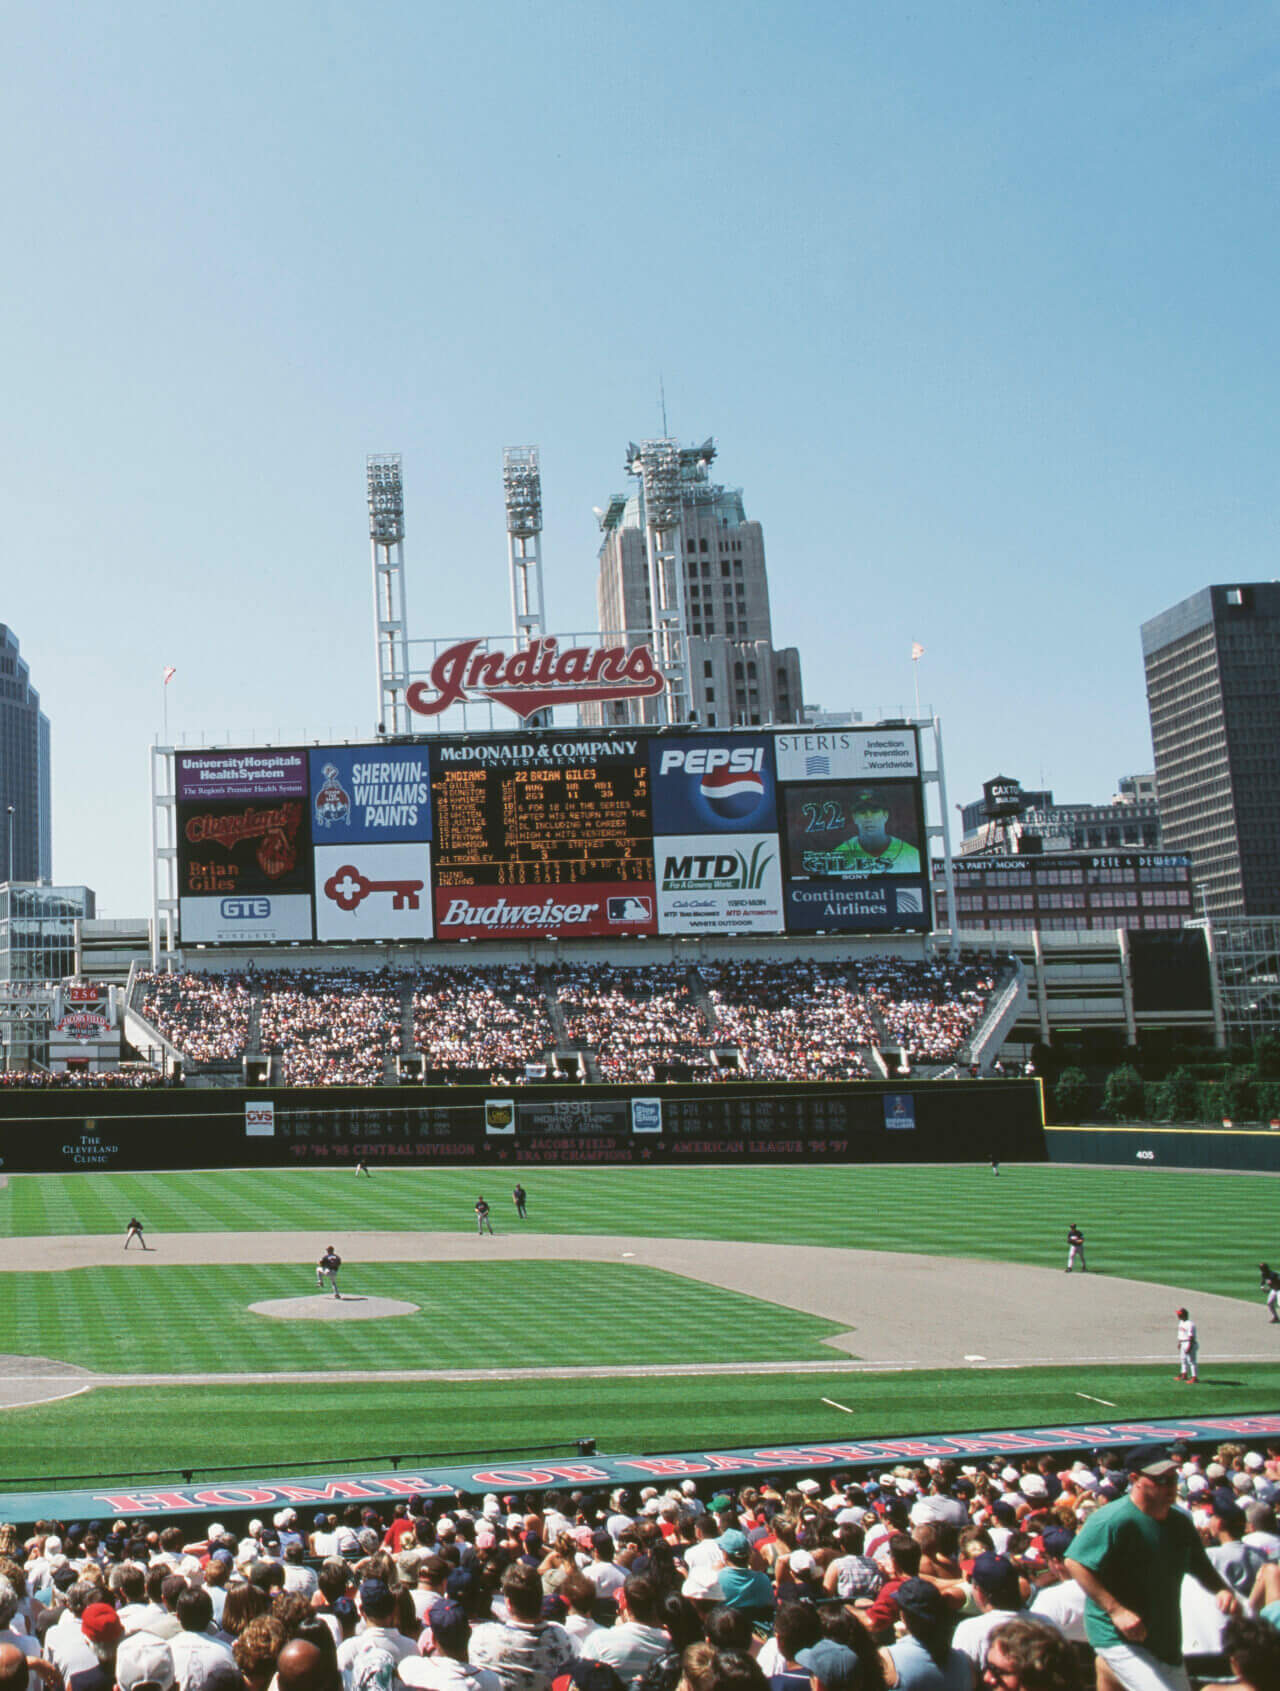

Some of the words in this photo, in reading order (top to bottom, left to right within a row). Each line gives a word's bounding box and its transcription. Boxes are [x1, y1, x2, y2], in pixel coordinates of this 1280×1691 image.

[406, 637, 665, 720] Indians
[779, 735, 850, 751] STERIS
[867, 740, 904, 748] Infection
[441, 746, 534, 761] McDONALD
[538, 745, 549, 757] &
[552, 742, 637, 757] COMPANY
[864, 749, 909, 757] Prevention
[482, 757, 597, 767] INVESTMENTS
[660, 747, 764, 775] PEPSI
[352, 762, 428, 784] SHERWIN-
[445, 771, 487, 781] INDIANS
[515, 772, 528, 782] 22
[531, 770, 561, 780] BRIAN
[566, 769, 597, 780] GILES
[634, 768, 647, 778] LF
[279, 784, 302, 792] System
[449, 781, 475, 789] GILES
[354, 783, 427, 805] WILLIAMS
[568, 791, 578, 799] 11
[600, 801, 631, 809] SERIES
[365, 805, 418, 827] PAINTS
[570, 811, 600, 819] RETURN
[632, 809, 647, 817] THE
[802, 801, 846, 832] 22
[536, 821, 582, 829] INCLUDING
[541, 850, 548, 859] 3
[584, 849, 588, 859] 1
[624, 848, 631, 857] 2
[189, 861, 239, 876] Brian
[664, 855, 738, 879] MTD
[802, 857, 895, 873] GILES
[933, 862, 964, 870] JUA'S
[189, 876, 236, 891] Giles
[791, 888, 886, 903] Continental
[223, 900, 269, 917] GTE
[441, 899, 599, 925] Budweiser
[824, 902, 888, 915] Airlines
[554, 1102, 592, 1114] 1998
[247, 1110, 273, 1122] CVS
[80, 1136, 101, 1144] THE
[579, 1138, 617, 1149] FIELD
[62, 1145, 118, 1153] CLEVELAND
[353, 1144, 412, 1155] CENTRAL
[416, 1143, 475, 1155] DIVISION
[672, 1141, 744, 1153] AMERICAN
[749, 1141, 803, 1152] LEAGUE
[73, 1154, 108, 1163] CLINIC
[545, 1150, 559, 1161] OF
[561, 1150, 633, 1161] CHAMPIONS
[1136, 1151, 1154, 1160] 405
[92, 1476, 454, 1513] HOME
[472, 1461, 612, 1487] OF
[615, 1426, 1197, 1476] BASEBALL'S
